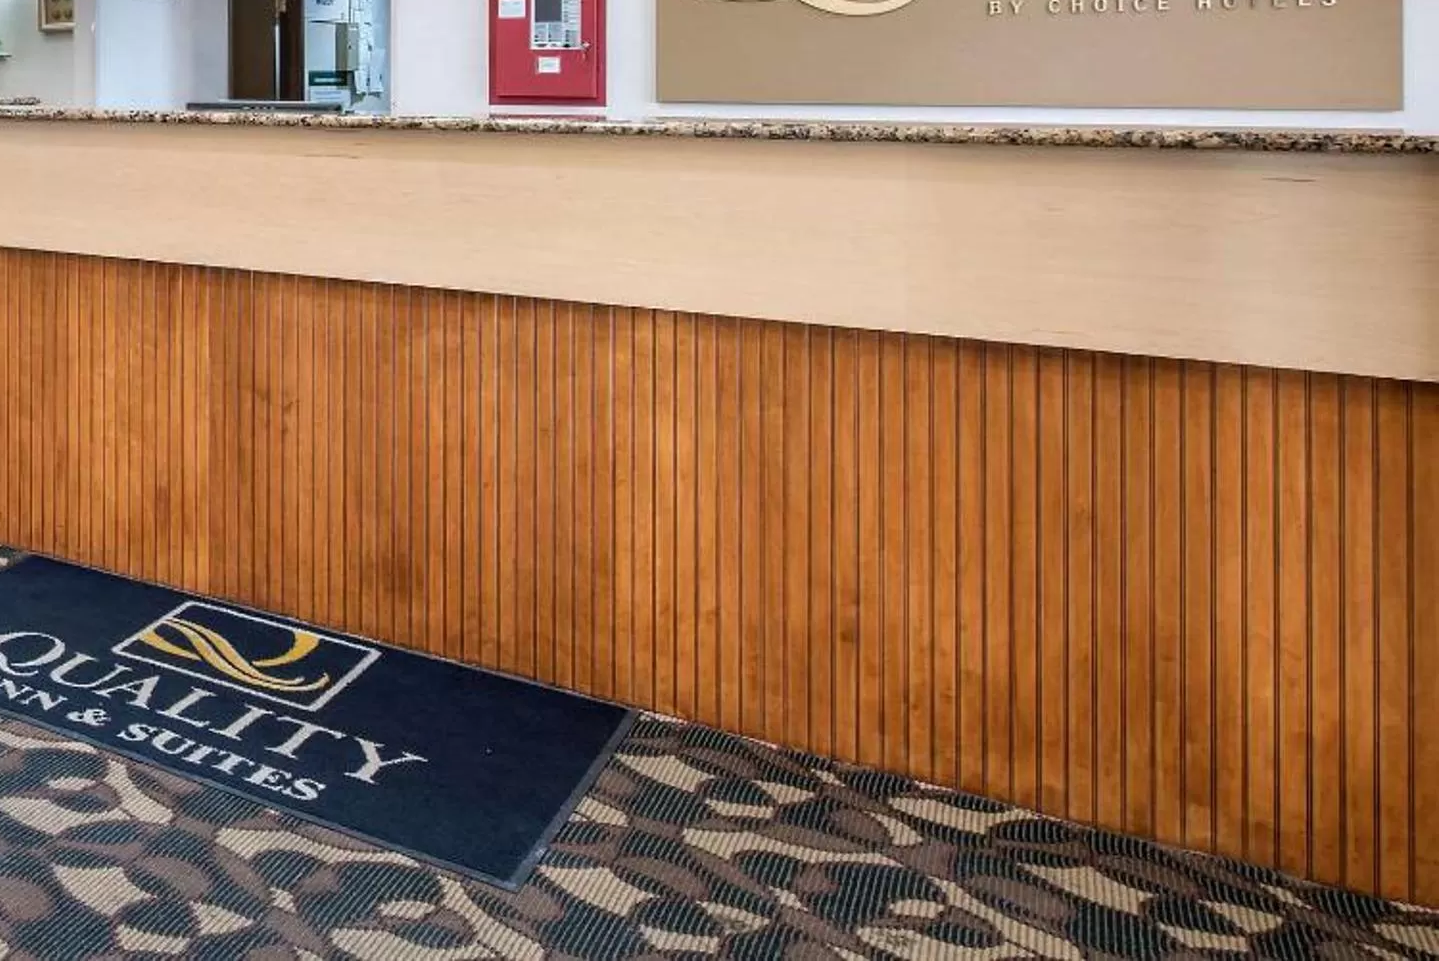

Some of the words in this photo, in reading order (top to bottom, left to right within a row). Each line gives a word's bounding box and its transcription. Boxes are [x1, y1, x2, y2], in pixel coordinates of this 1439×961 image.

[986, 0, 1025, 16] BY
[66, 707, 112, 727] &
[116, 722, 327, 802] SUITES
